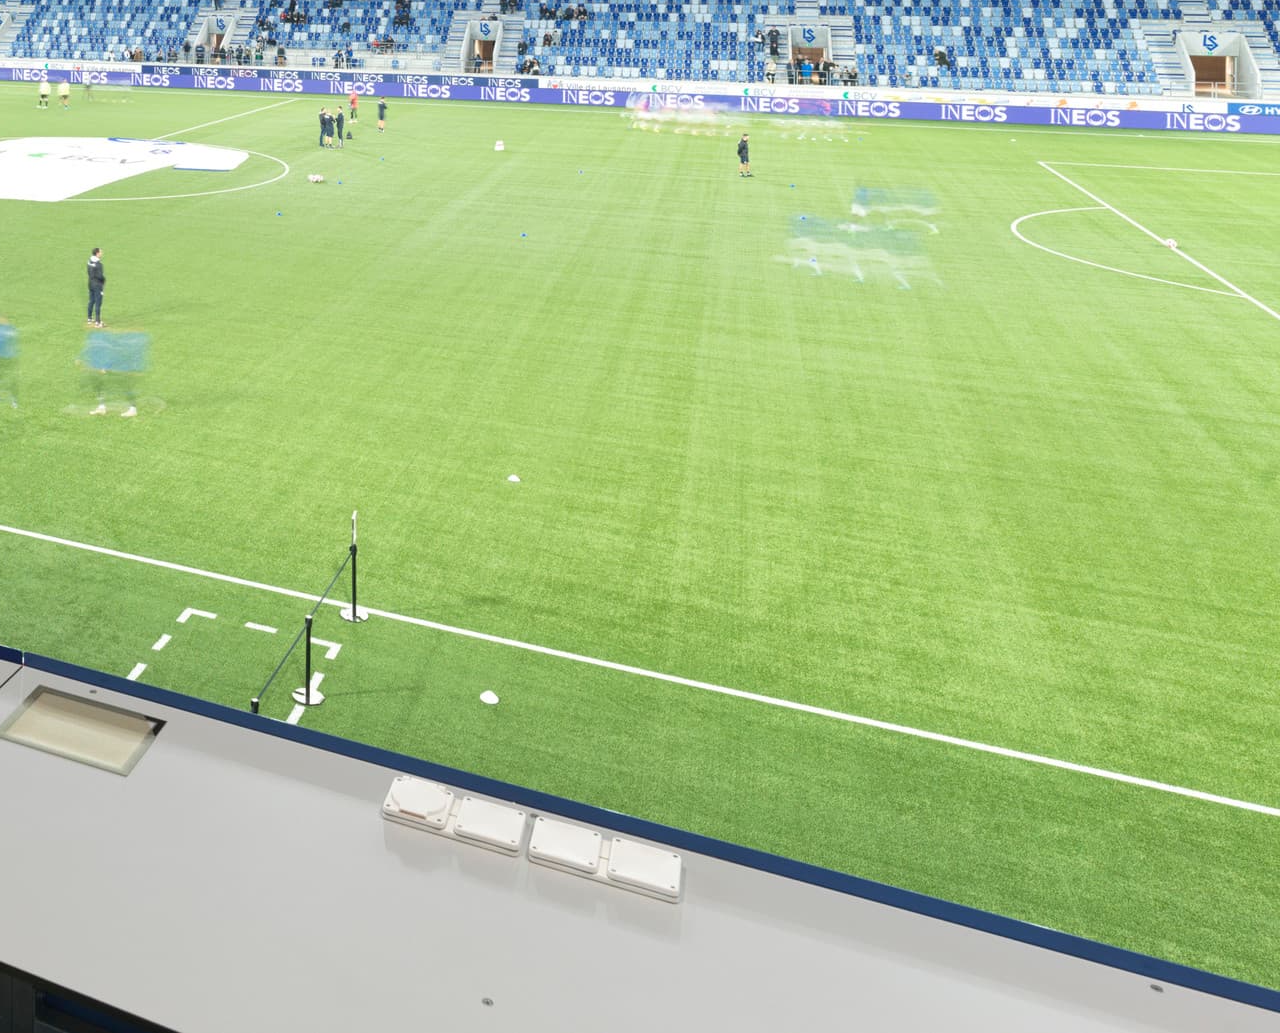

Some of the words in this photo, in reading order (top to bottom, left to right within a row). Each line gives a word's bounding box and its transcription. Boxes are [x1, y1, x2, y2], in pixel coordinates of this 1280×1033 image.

[12, 69, 48, 81] INEOS
[71, 71, 108, 84] INEOS
[154, 67, 180, 75] INEOS
[191, 68, 218, 76] INEOS
[230, 69, 258, 78] INEOS
[270, 71, 299, 80] INEOS
[311, 72, 341, 81] INEOS
[131, 73, 169, 86] INEOS
[195, 76, 235, 89] INEOS
[353, 73, 384, 83] INEOS
[397, 75, 428, 84] INEOS
[442, 77, 474, 86] INEOS
[488, 78, 521, 87] INEOS
[260, 79, 303, 92] INEOS
[330, 81, 375, 95] INEOS
[403, 84, 451, 98] INEOS
[480, 86, 530, 102] INEOS
[562, 90, 615, 105] INEOS
[649, 94, 704, 108] INEOS
[741, 97, 800, 113] INEOS
[838, 100, 901, 117] INEOS
[941, 104, 1007, 122] INEOS
[1050, 109, 1120, 126] INEOS
[1166, 113, 1241, 131] INEOS
